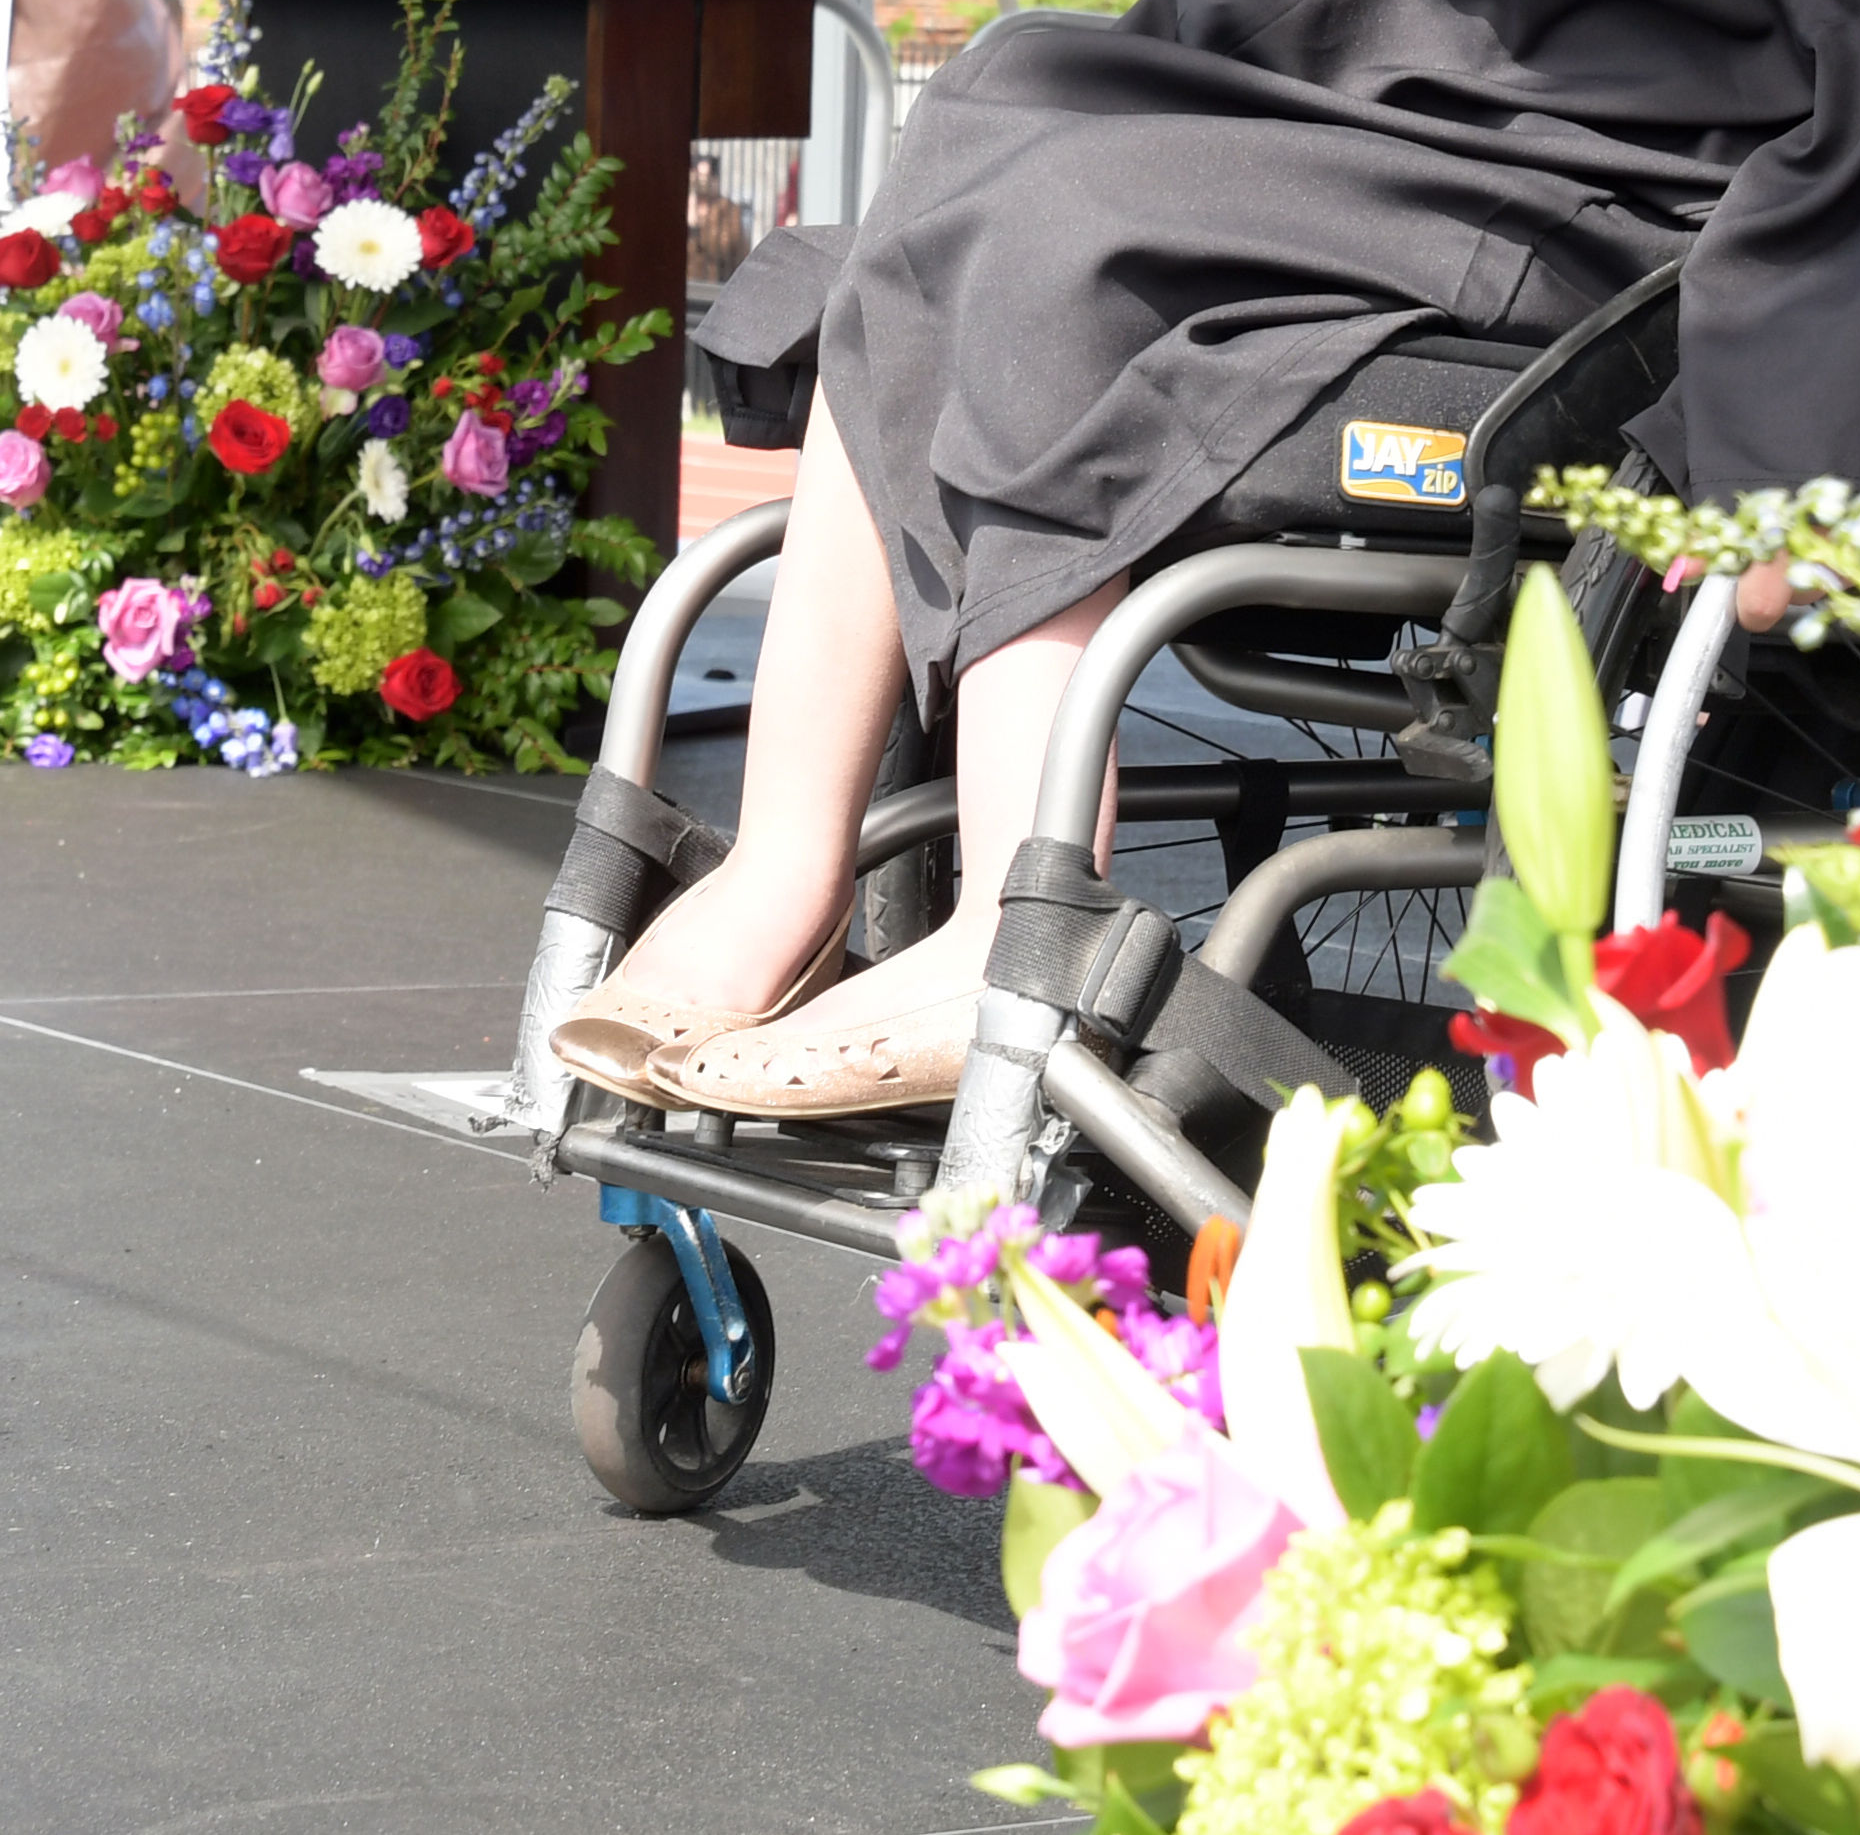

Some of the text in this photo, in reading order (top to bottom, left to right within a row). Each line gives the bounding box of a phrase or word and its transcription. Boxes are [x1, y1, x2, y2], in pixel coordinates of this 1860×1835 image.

[1352, 432, 1427, 477] JAY
[1687, 844, 1755, 855] SPECIALIST
[1703, 859, 1744, 868] move
